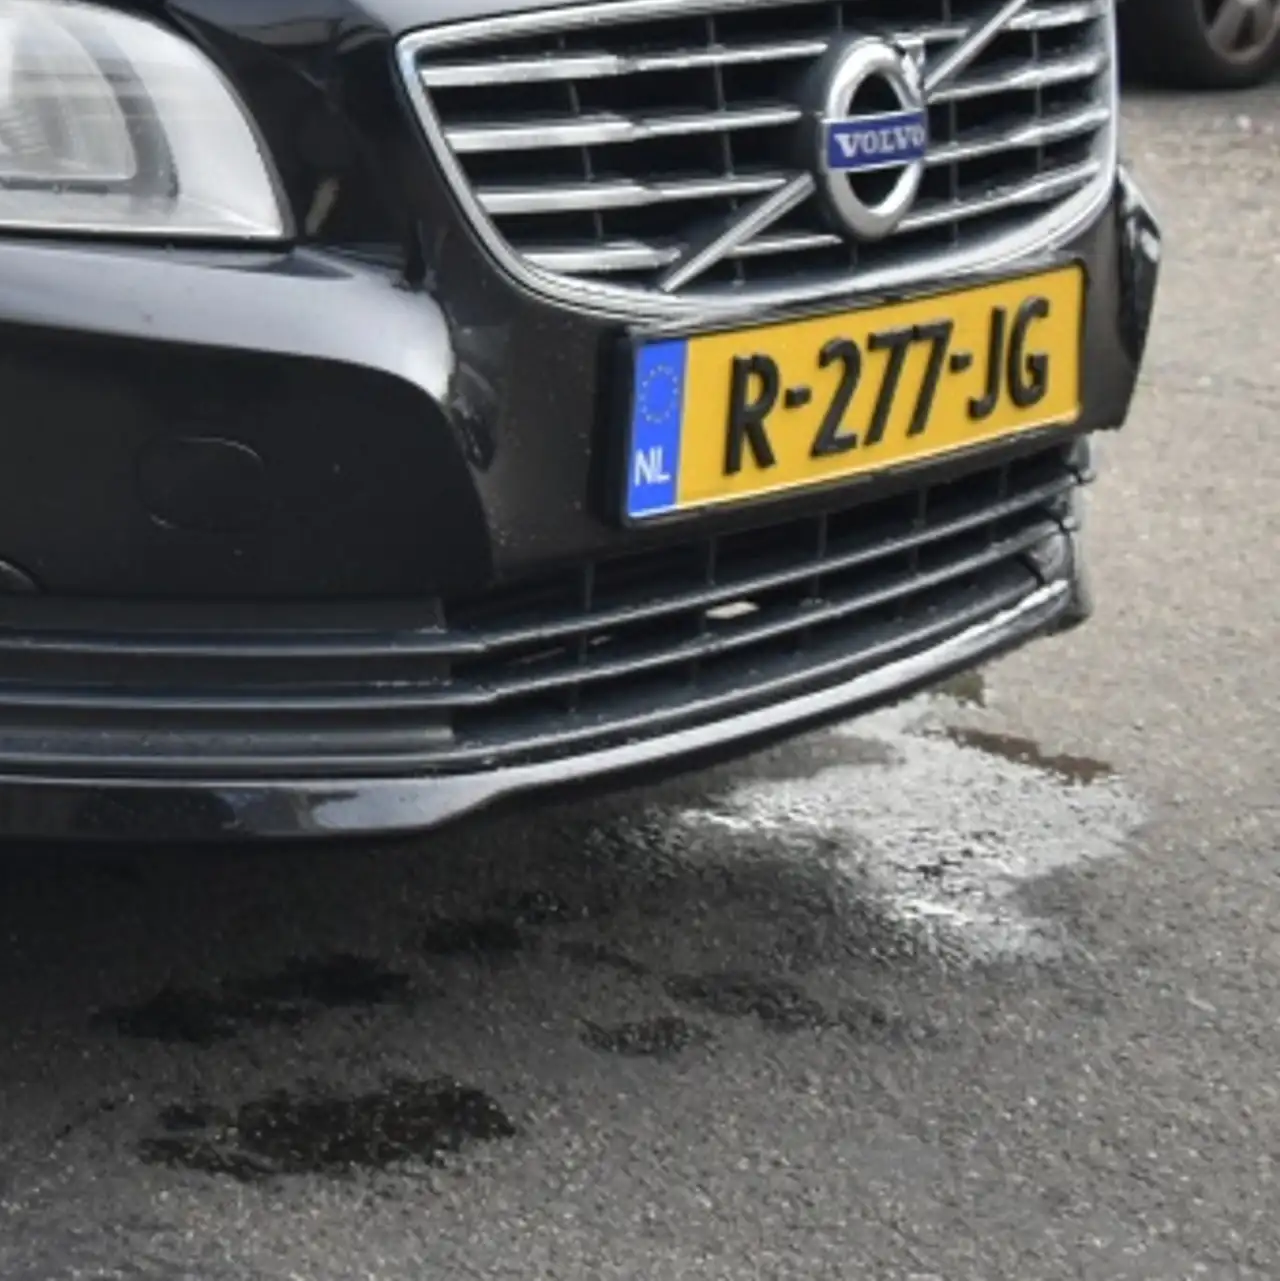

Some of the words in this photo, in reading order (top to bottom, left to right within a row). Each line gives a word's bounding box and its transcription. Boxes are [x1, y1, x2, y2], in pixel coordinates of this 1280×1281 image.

[834, 124, 925, 157] VOLVO
[722, 296, 1050, 477] R-277-JG
[634, 447, 670, 486] NL
